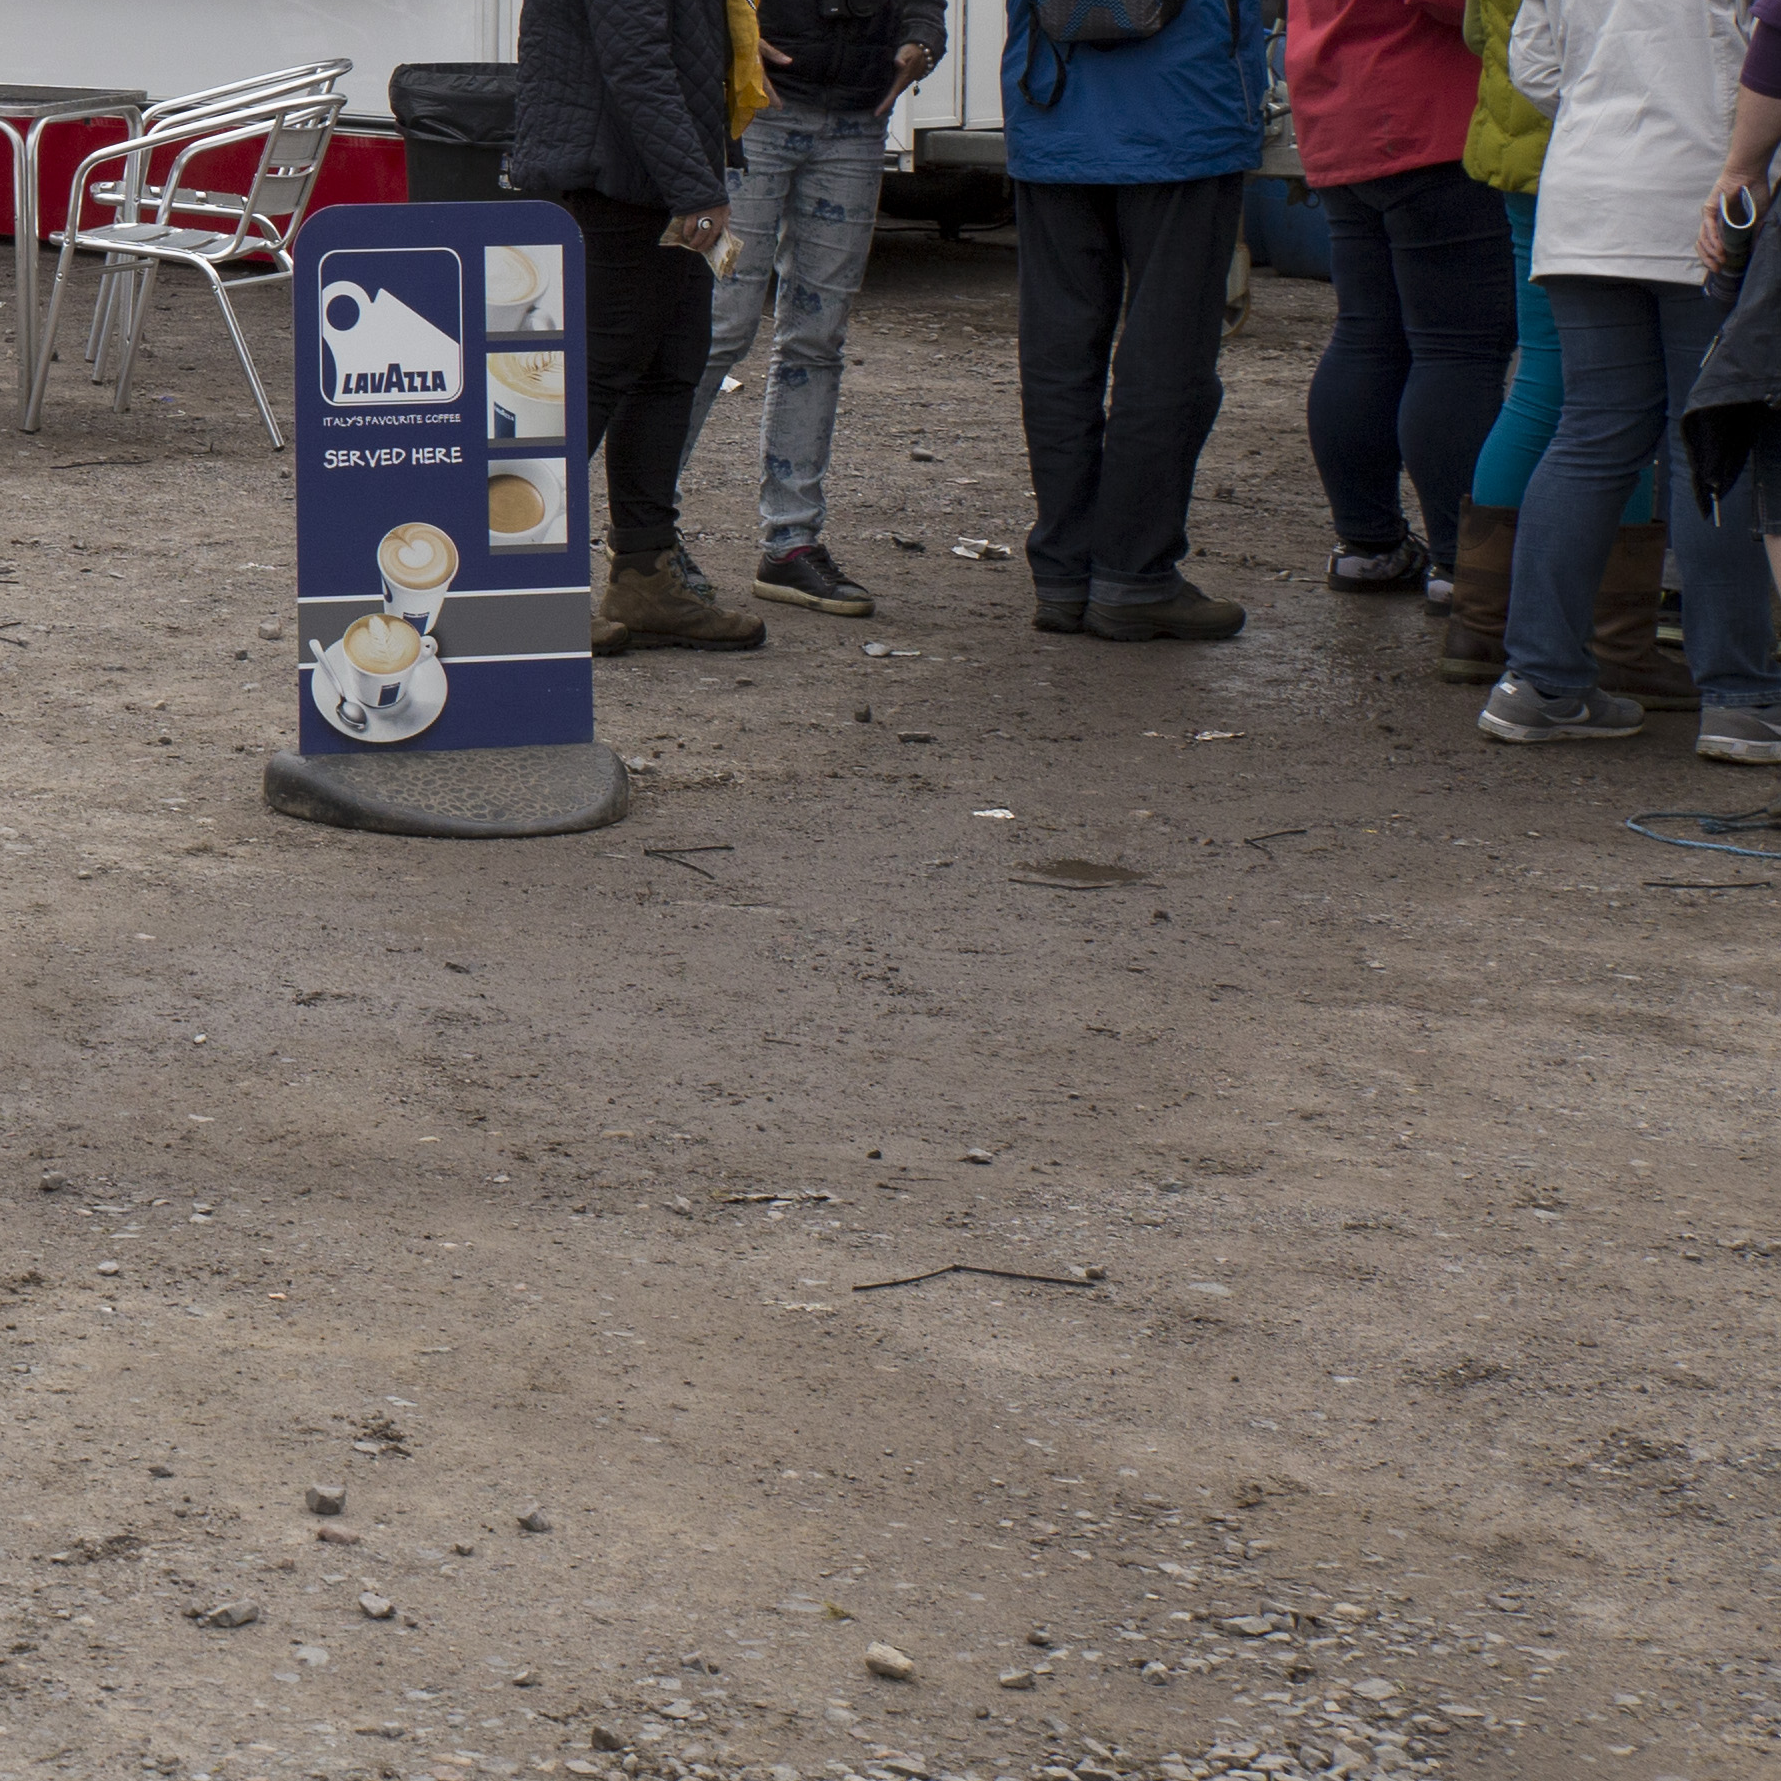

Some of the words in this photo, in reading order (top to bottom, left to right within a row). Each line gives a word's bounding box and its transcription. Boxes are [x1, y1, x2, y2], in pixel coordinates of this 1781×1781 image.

[342, 363, 446, 394] LAVAZZA
[323, 416, 363, 427] ITALY'S
[365, 414, 422, 425] FAVOURITE
[425, 414, 461, 423] COFFEE
[324, 448, 406, 469] SERVED
[412, 447, 462, 465] HERE
